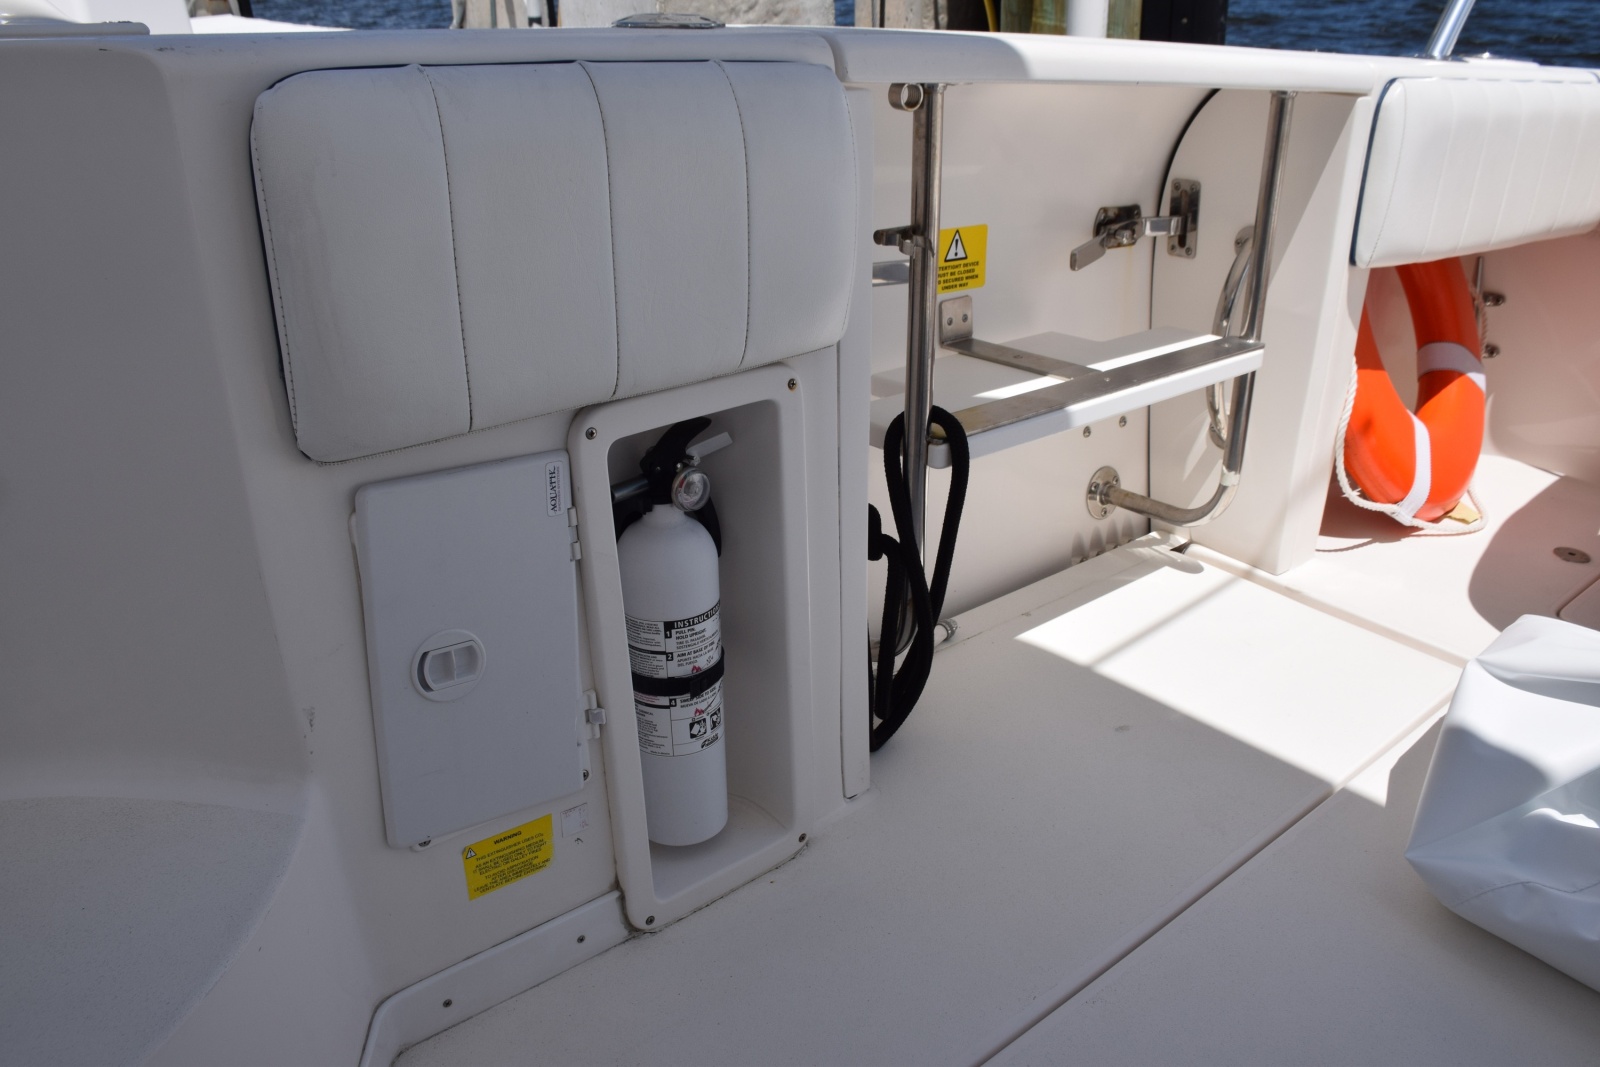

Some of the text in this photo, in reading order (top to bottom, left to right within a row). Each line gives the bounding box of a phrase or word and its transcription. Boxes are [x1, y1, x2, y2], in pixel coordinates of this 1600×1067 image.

[674, 603, 720, 628] INSTRUCTION
[494, 830, 521, 844] WARNING
[487, 841, 521, 857] EXTINGUISHER
[511, 853, 527, 862] GALLEY
[474, 884, 488, 892] LEAVE
[480, 881, 503, 893] VENTILATE
[504, 873, 523, 883] BEFORE
